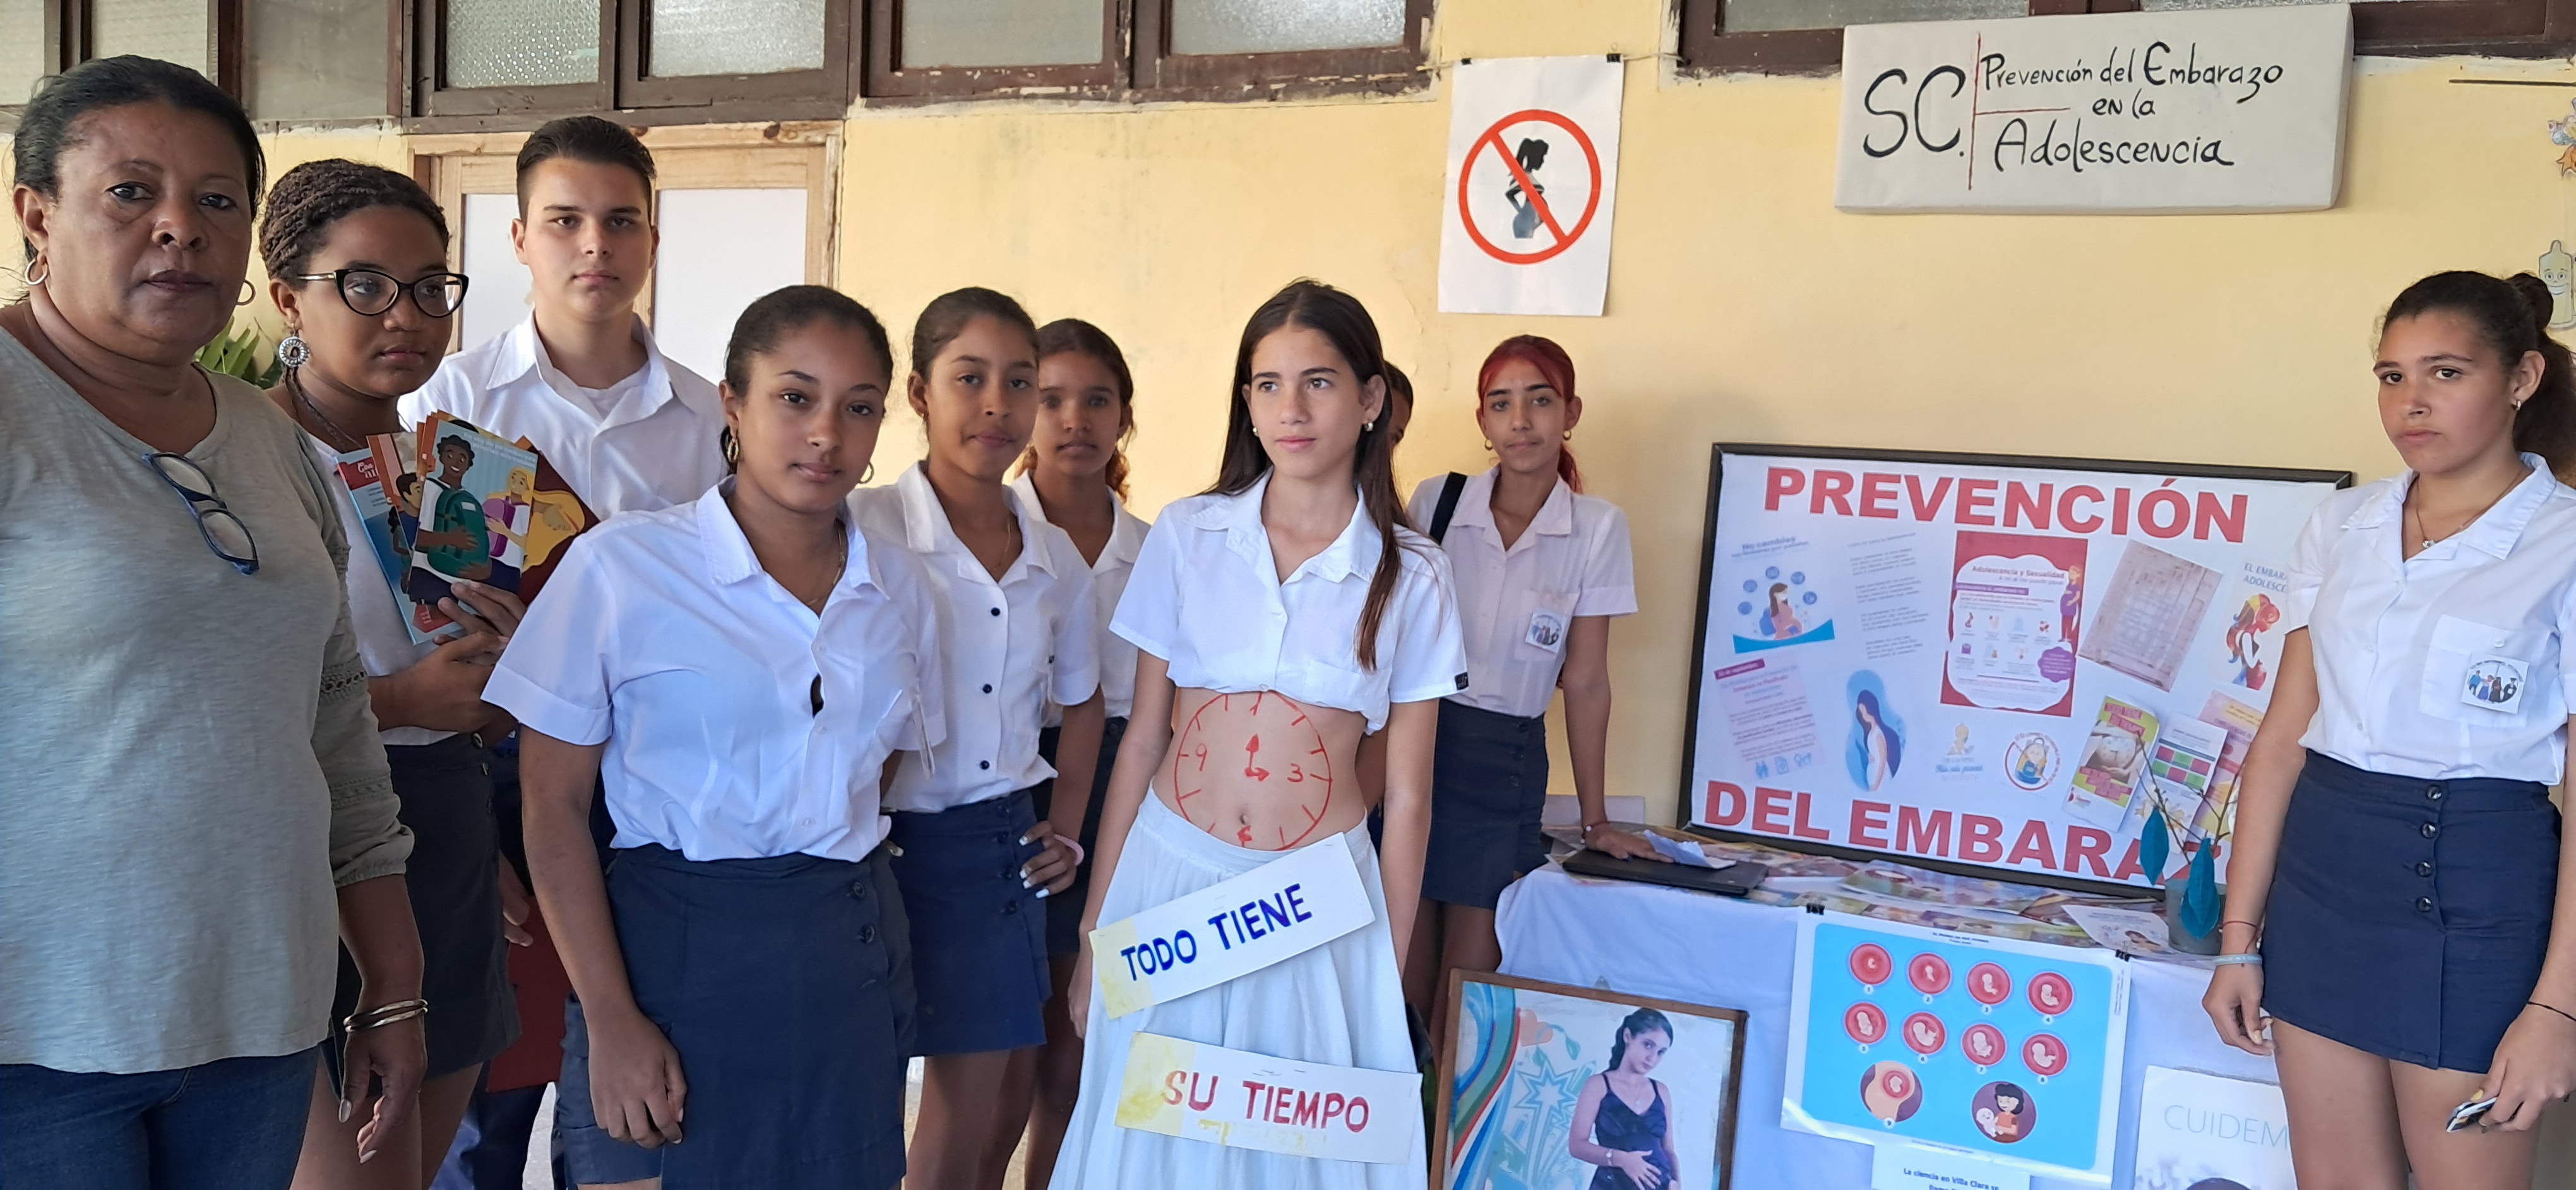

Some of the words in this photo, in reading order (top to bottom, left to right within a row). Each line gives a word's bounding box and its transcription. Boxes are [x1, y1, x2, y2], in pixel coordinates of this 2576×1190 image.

[1980, 54, 2093, 91] Prevención
[2099, 47, 2135, 85] del
[2144, 42, 2284, 104] Embarazo
[1863, 65, 1965, 158] SC.
[2132, 89, 2156, 119] la
[1995, 118, 2236, 173] Adolescencia
[1765, 467, 2249, 544] PREVENCIÓN
[2244, 563, 2253, 572] EL
[2256, 565, 2287, 580] EMBAR
[1195, 743, 1207, 771] 9
[1287, 763, 1304, 783] 3
[1705, 779, 1830, 841] DEL
[1120, 929, 1198, 982] TODO
[1207, 883, 1313, 951] TIENE
[1161, 1070, 1219, 1112] SU
[1243, 1080, 1369, 1133] TIEMPO
[2164, 1105, 2288, 1150] CUIDEM
[1903, 1167, 1912, 1175] La
[1952, 1176, 1968, 1186] Villa
[1969, 1180, 1989, 1189] Clara
